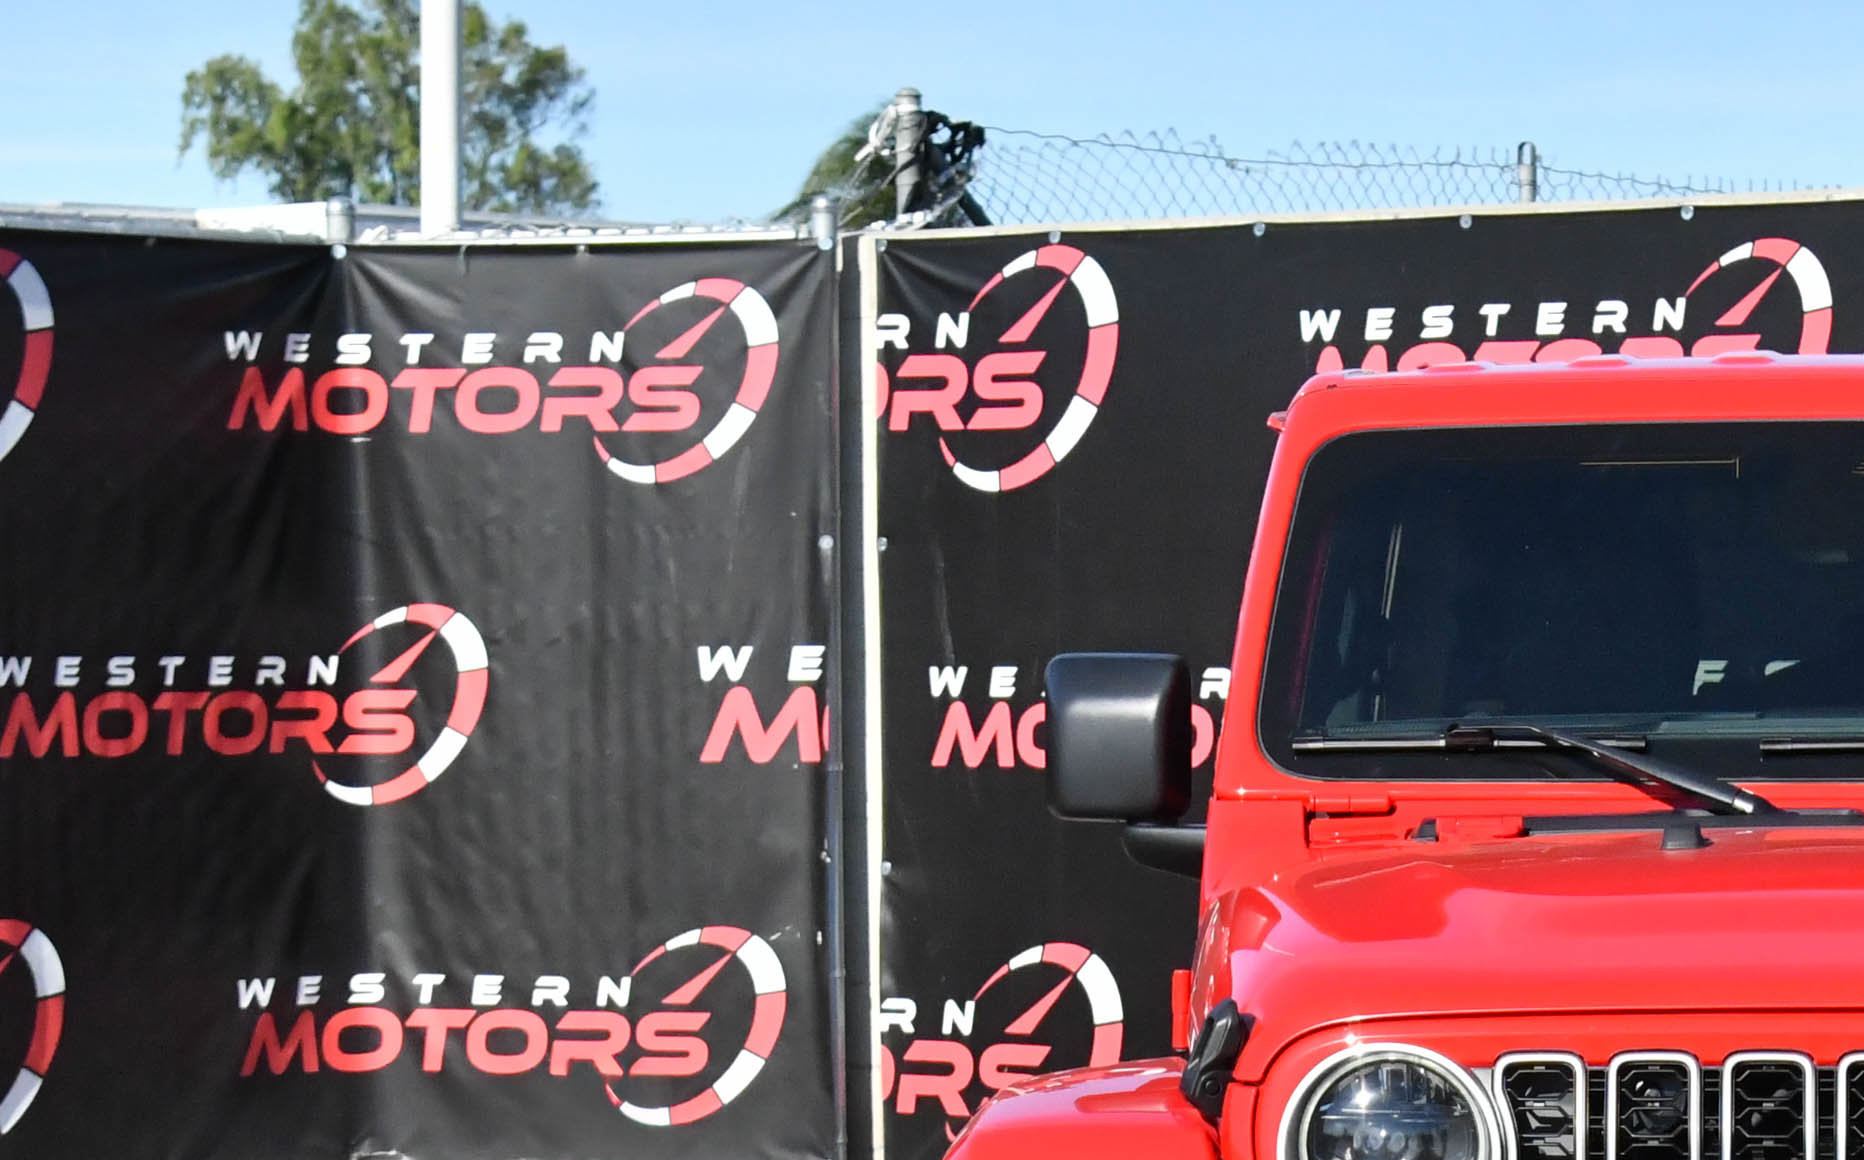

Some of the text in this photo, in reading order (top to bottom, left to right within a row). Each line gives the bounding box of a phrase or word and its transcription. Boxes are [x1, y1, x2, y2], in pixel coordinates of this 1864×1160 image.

[224, 327, 629, 366] WESTERN
[1299, 297, 1686, 342] WESTERN
[228, 365, 704, 434] MOTORS
[877, 350, 1047, 432] RS
[0, 655, 340, 688] WESTERN
[0, 687, 417, 759] MOTORS
[238, 972, 632, 1010] WESTERN
[240, 1005, 710, 1078] MOTORS
